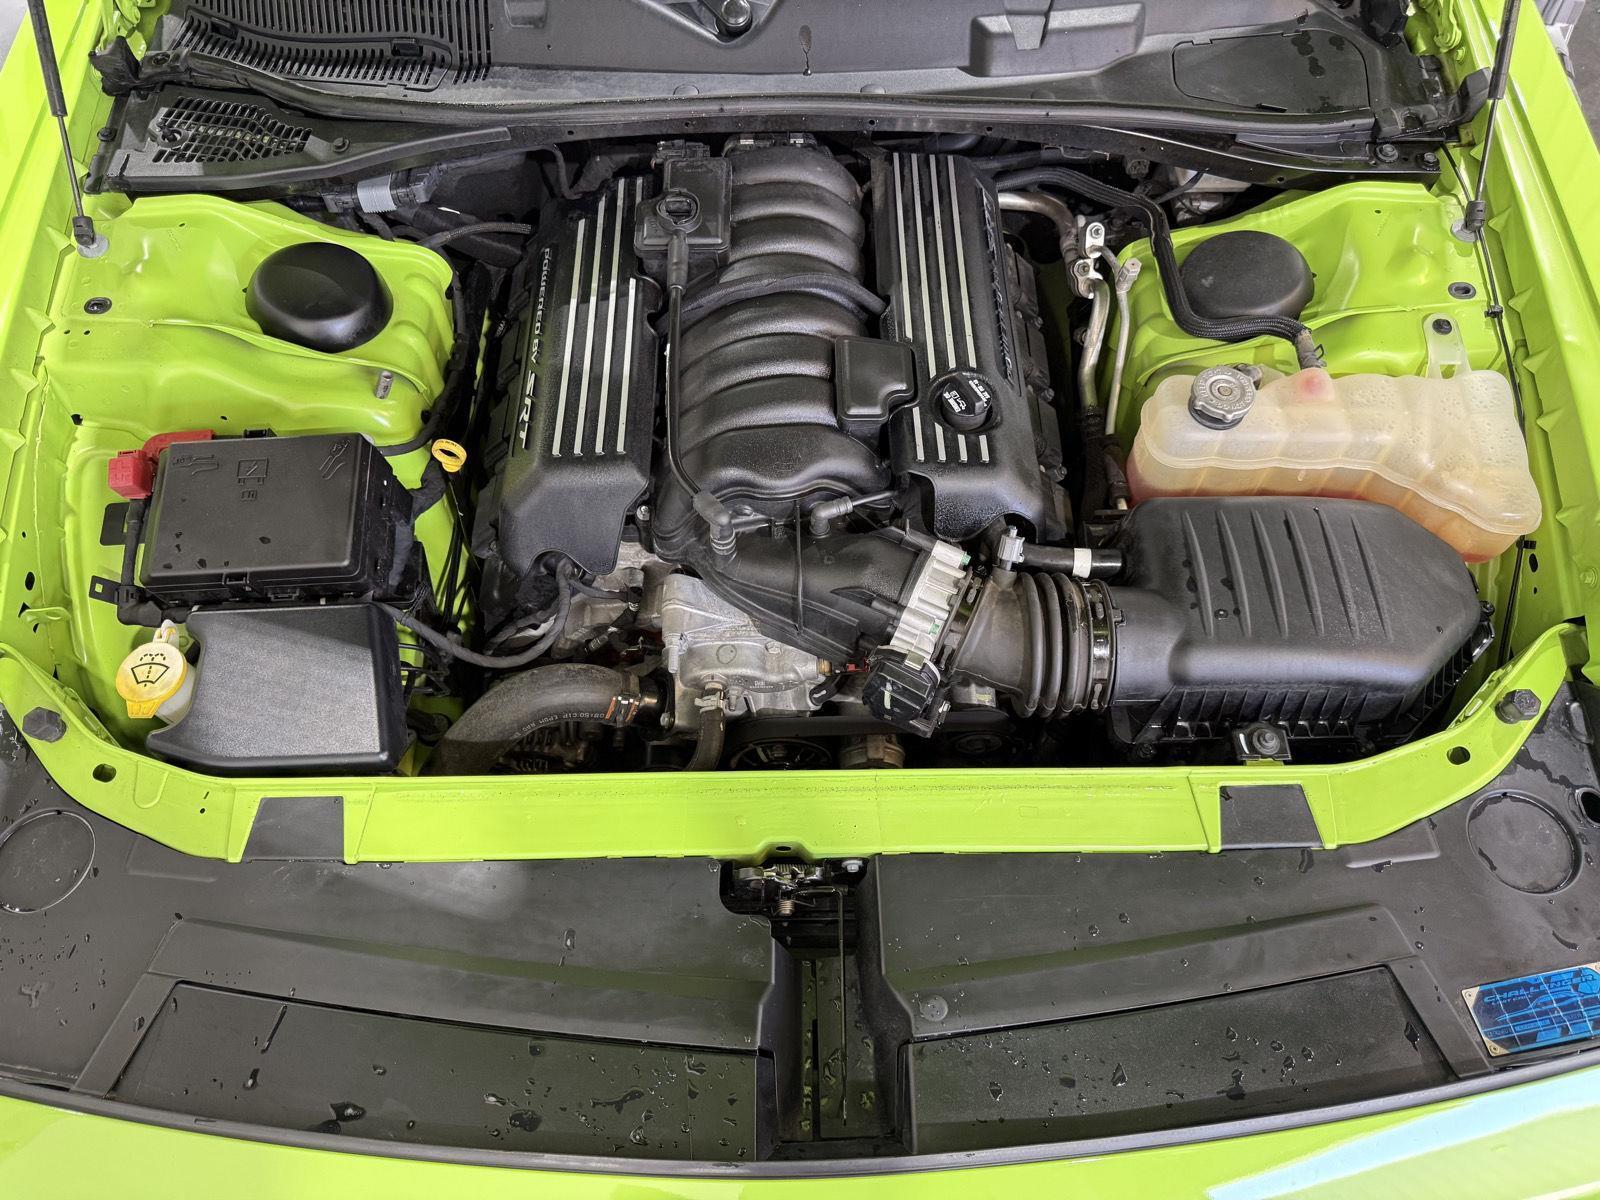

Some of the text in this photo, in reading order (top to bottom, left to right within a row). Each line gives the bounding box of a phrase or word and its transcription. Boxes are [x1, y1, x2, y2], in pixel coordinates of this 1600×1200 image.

[518, 248, 550, 449] POWERED BY SRT
[1484, 973, 1595, 1004] CHALLENGER
